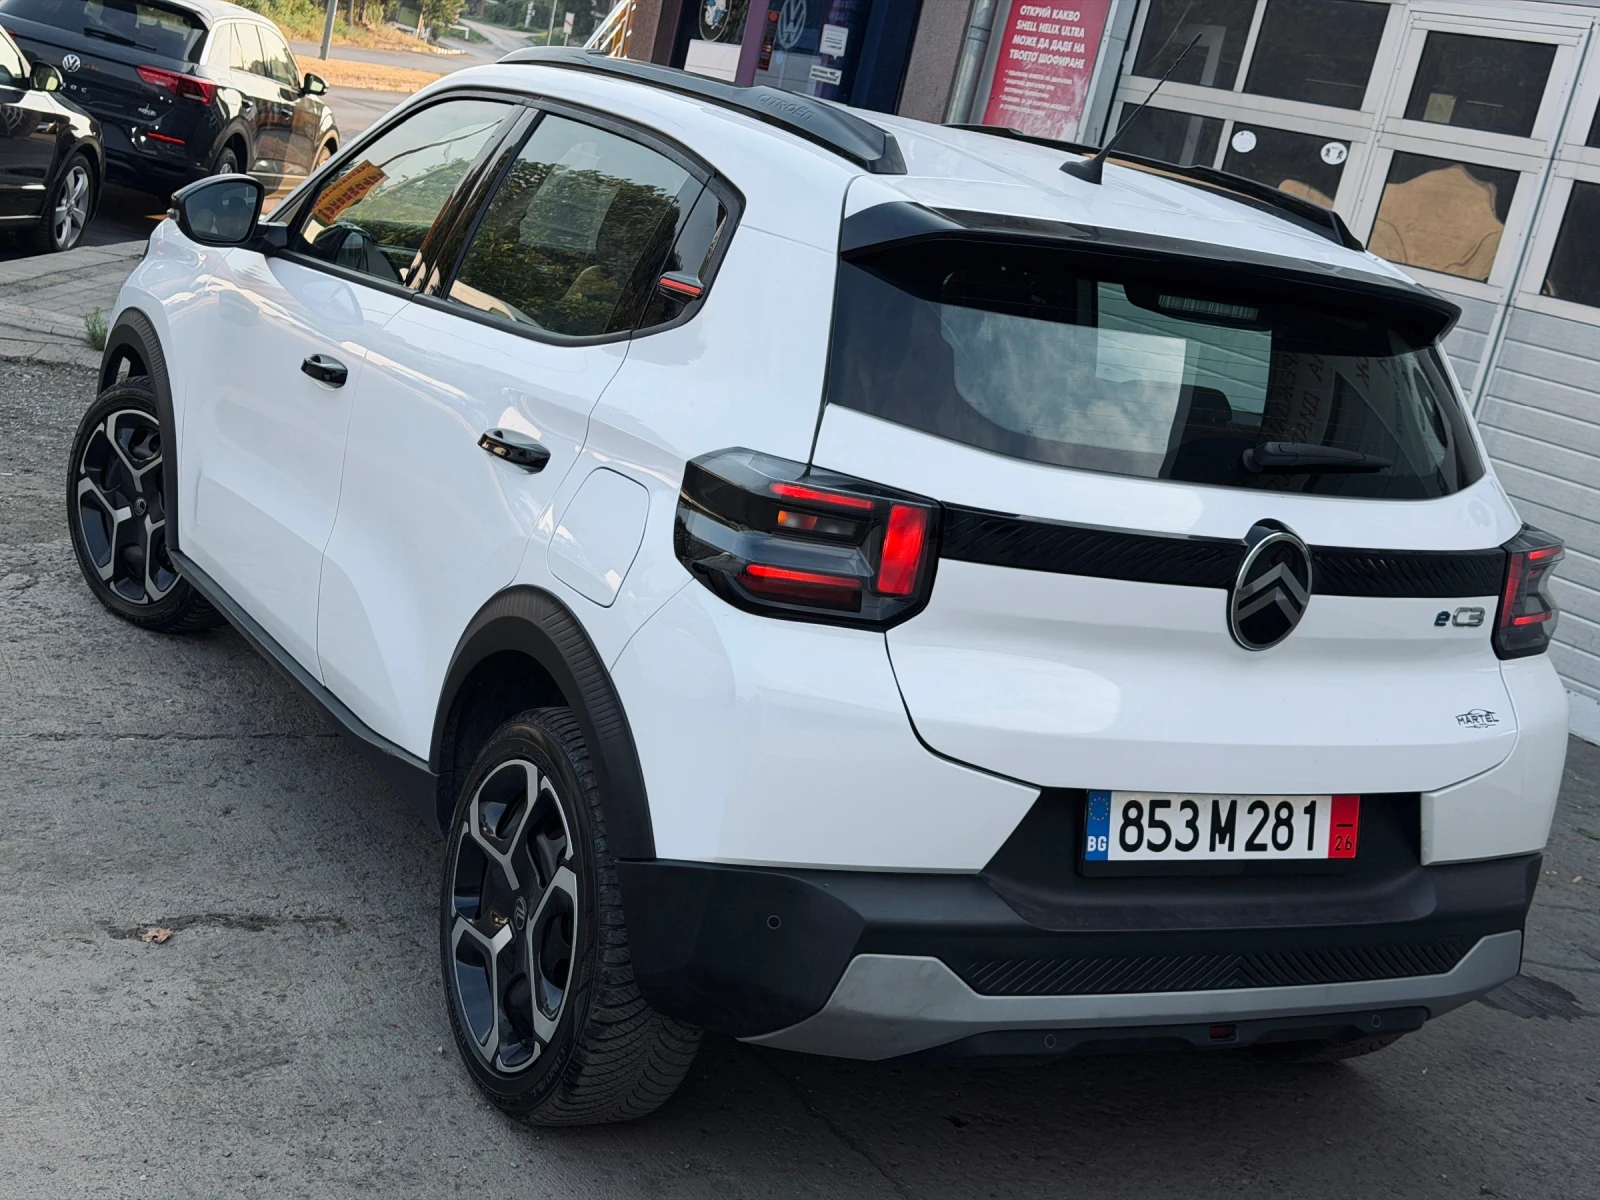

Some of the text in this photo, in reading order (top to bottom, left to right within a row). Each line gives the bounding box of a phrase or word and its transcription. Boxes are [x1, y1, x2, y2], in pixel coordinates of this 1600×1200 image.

[1020, 5, 1080, 21] ОТКРИЙ КАКВО
[1016, 19, 1085, 38] SHELL HELIX ULTRA
[1012, 34, 1085, 53] МОЖЕ ДА ДАДЕ НА
[1009, 48, 1086, 69] ТВОЕТО ШОФИРАНЕ
[1456, 714, 1500, 725] MARTEL
[1087, 835, 1107, 852] BG
[1335, 835, 1353, 851] 26
